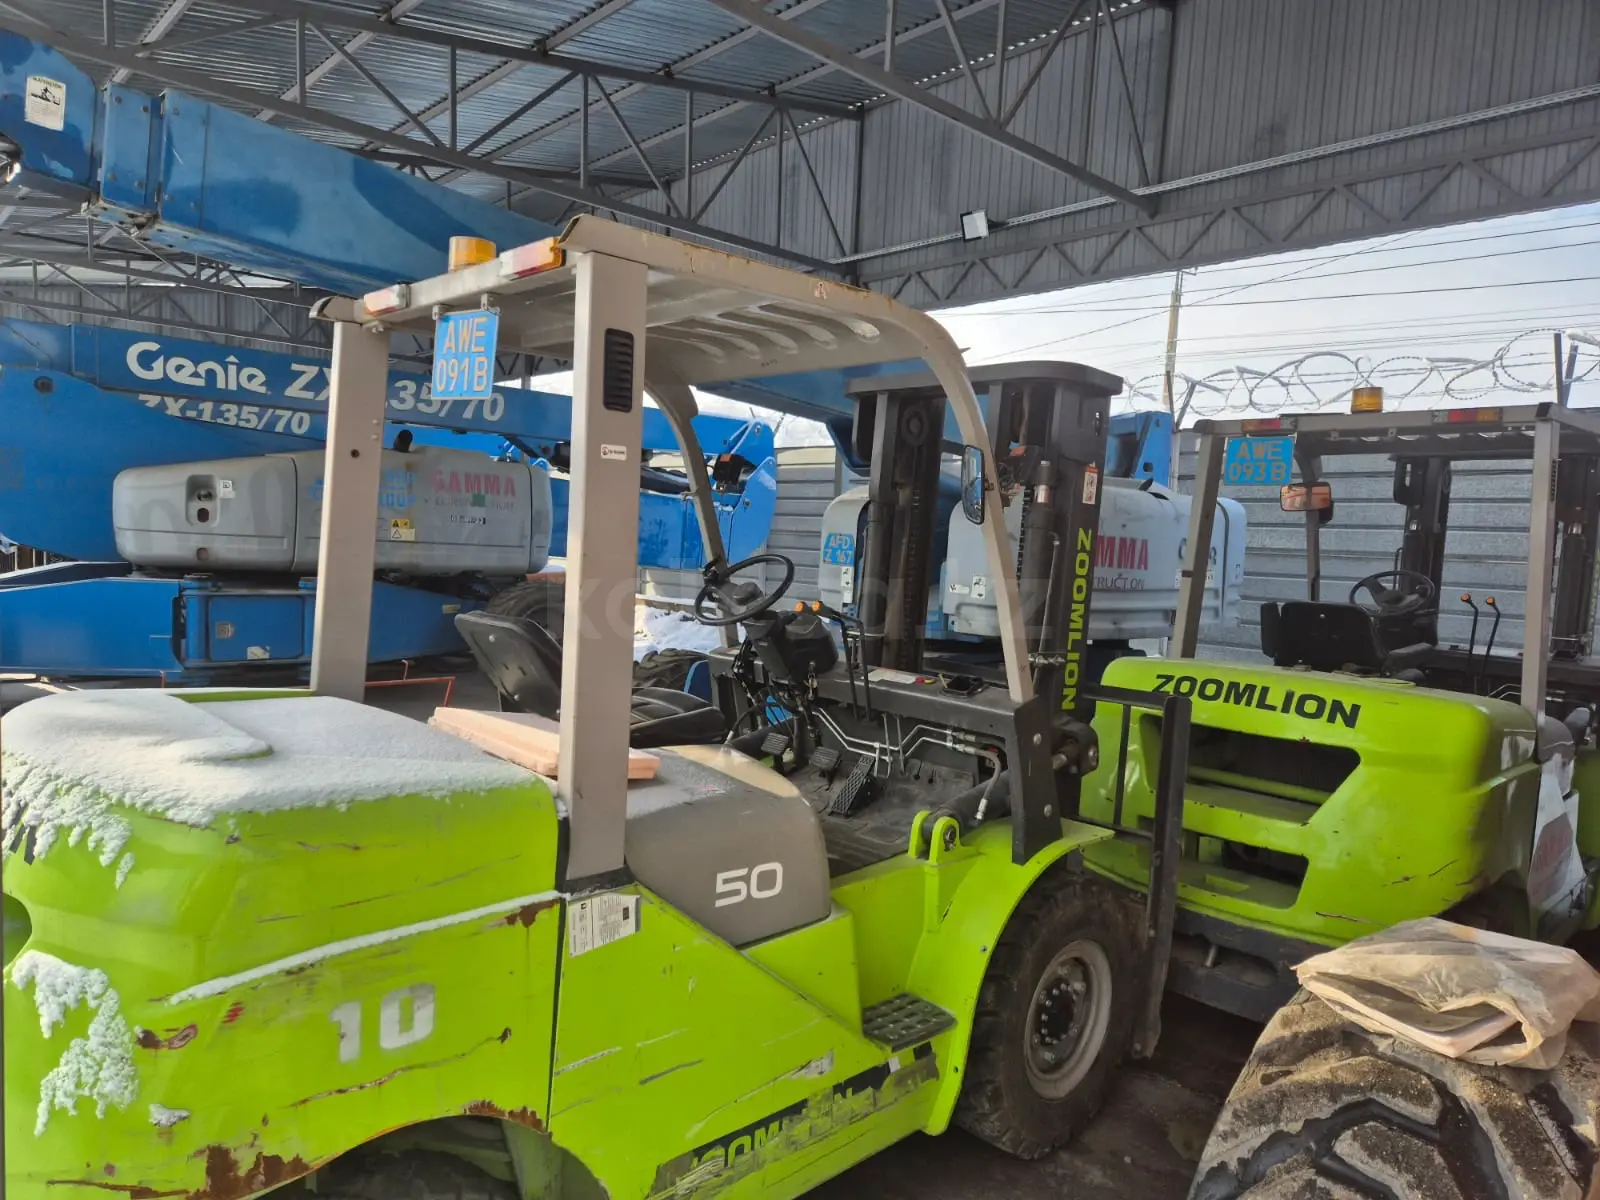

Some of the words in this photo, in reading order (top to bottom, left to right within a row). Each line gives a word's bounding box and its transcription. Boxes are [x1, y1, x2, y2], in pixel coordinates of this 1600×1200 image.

[442, 317, 488, 353] AWE
[126, 341, 267, 394] Genie
[1236, 440, 1284, 460] AWE
[431, 469, 516, 498] GAMMA
[1094, 535, 1148, 571] MMA
[1061, 527, 1093, 711] ZOOMLION
[1151, 673, 1362, 729] ZOOMLION
[714, 861, 783, 908] 50
[328, 983, 436, 1064] 10
